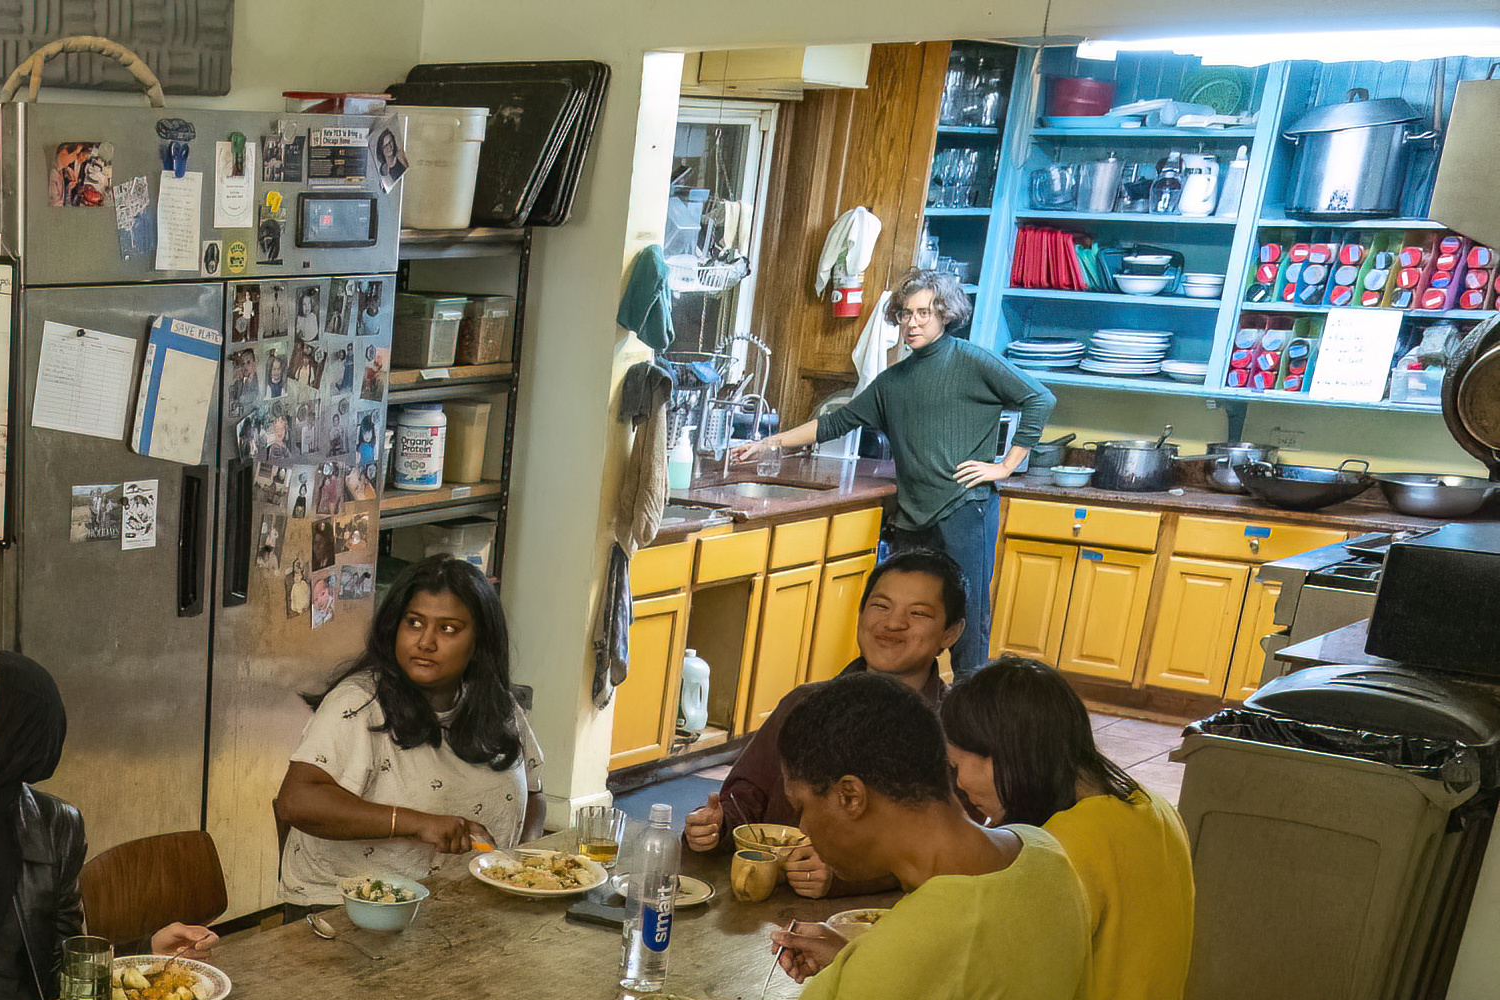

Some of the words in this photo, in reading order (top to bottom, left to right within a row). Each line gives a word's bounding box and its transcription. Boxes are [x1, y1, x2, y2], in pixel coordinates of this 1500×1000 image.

[173, 322, 195, 337] SAVE
[198, 328, 221, 343] PLATE
[401, 436, 434, 446] Organic
[402, 444, 432, 453] Protein
[655, 884, 674, 943] smart
